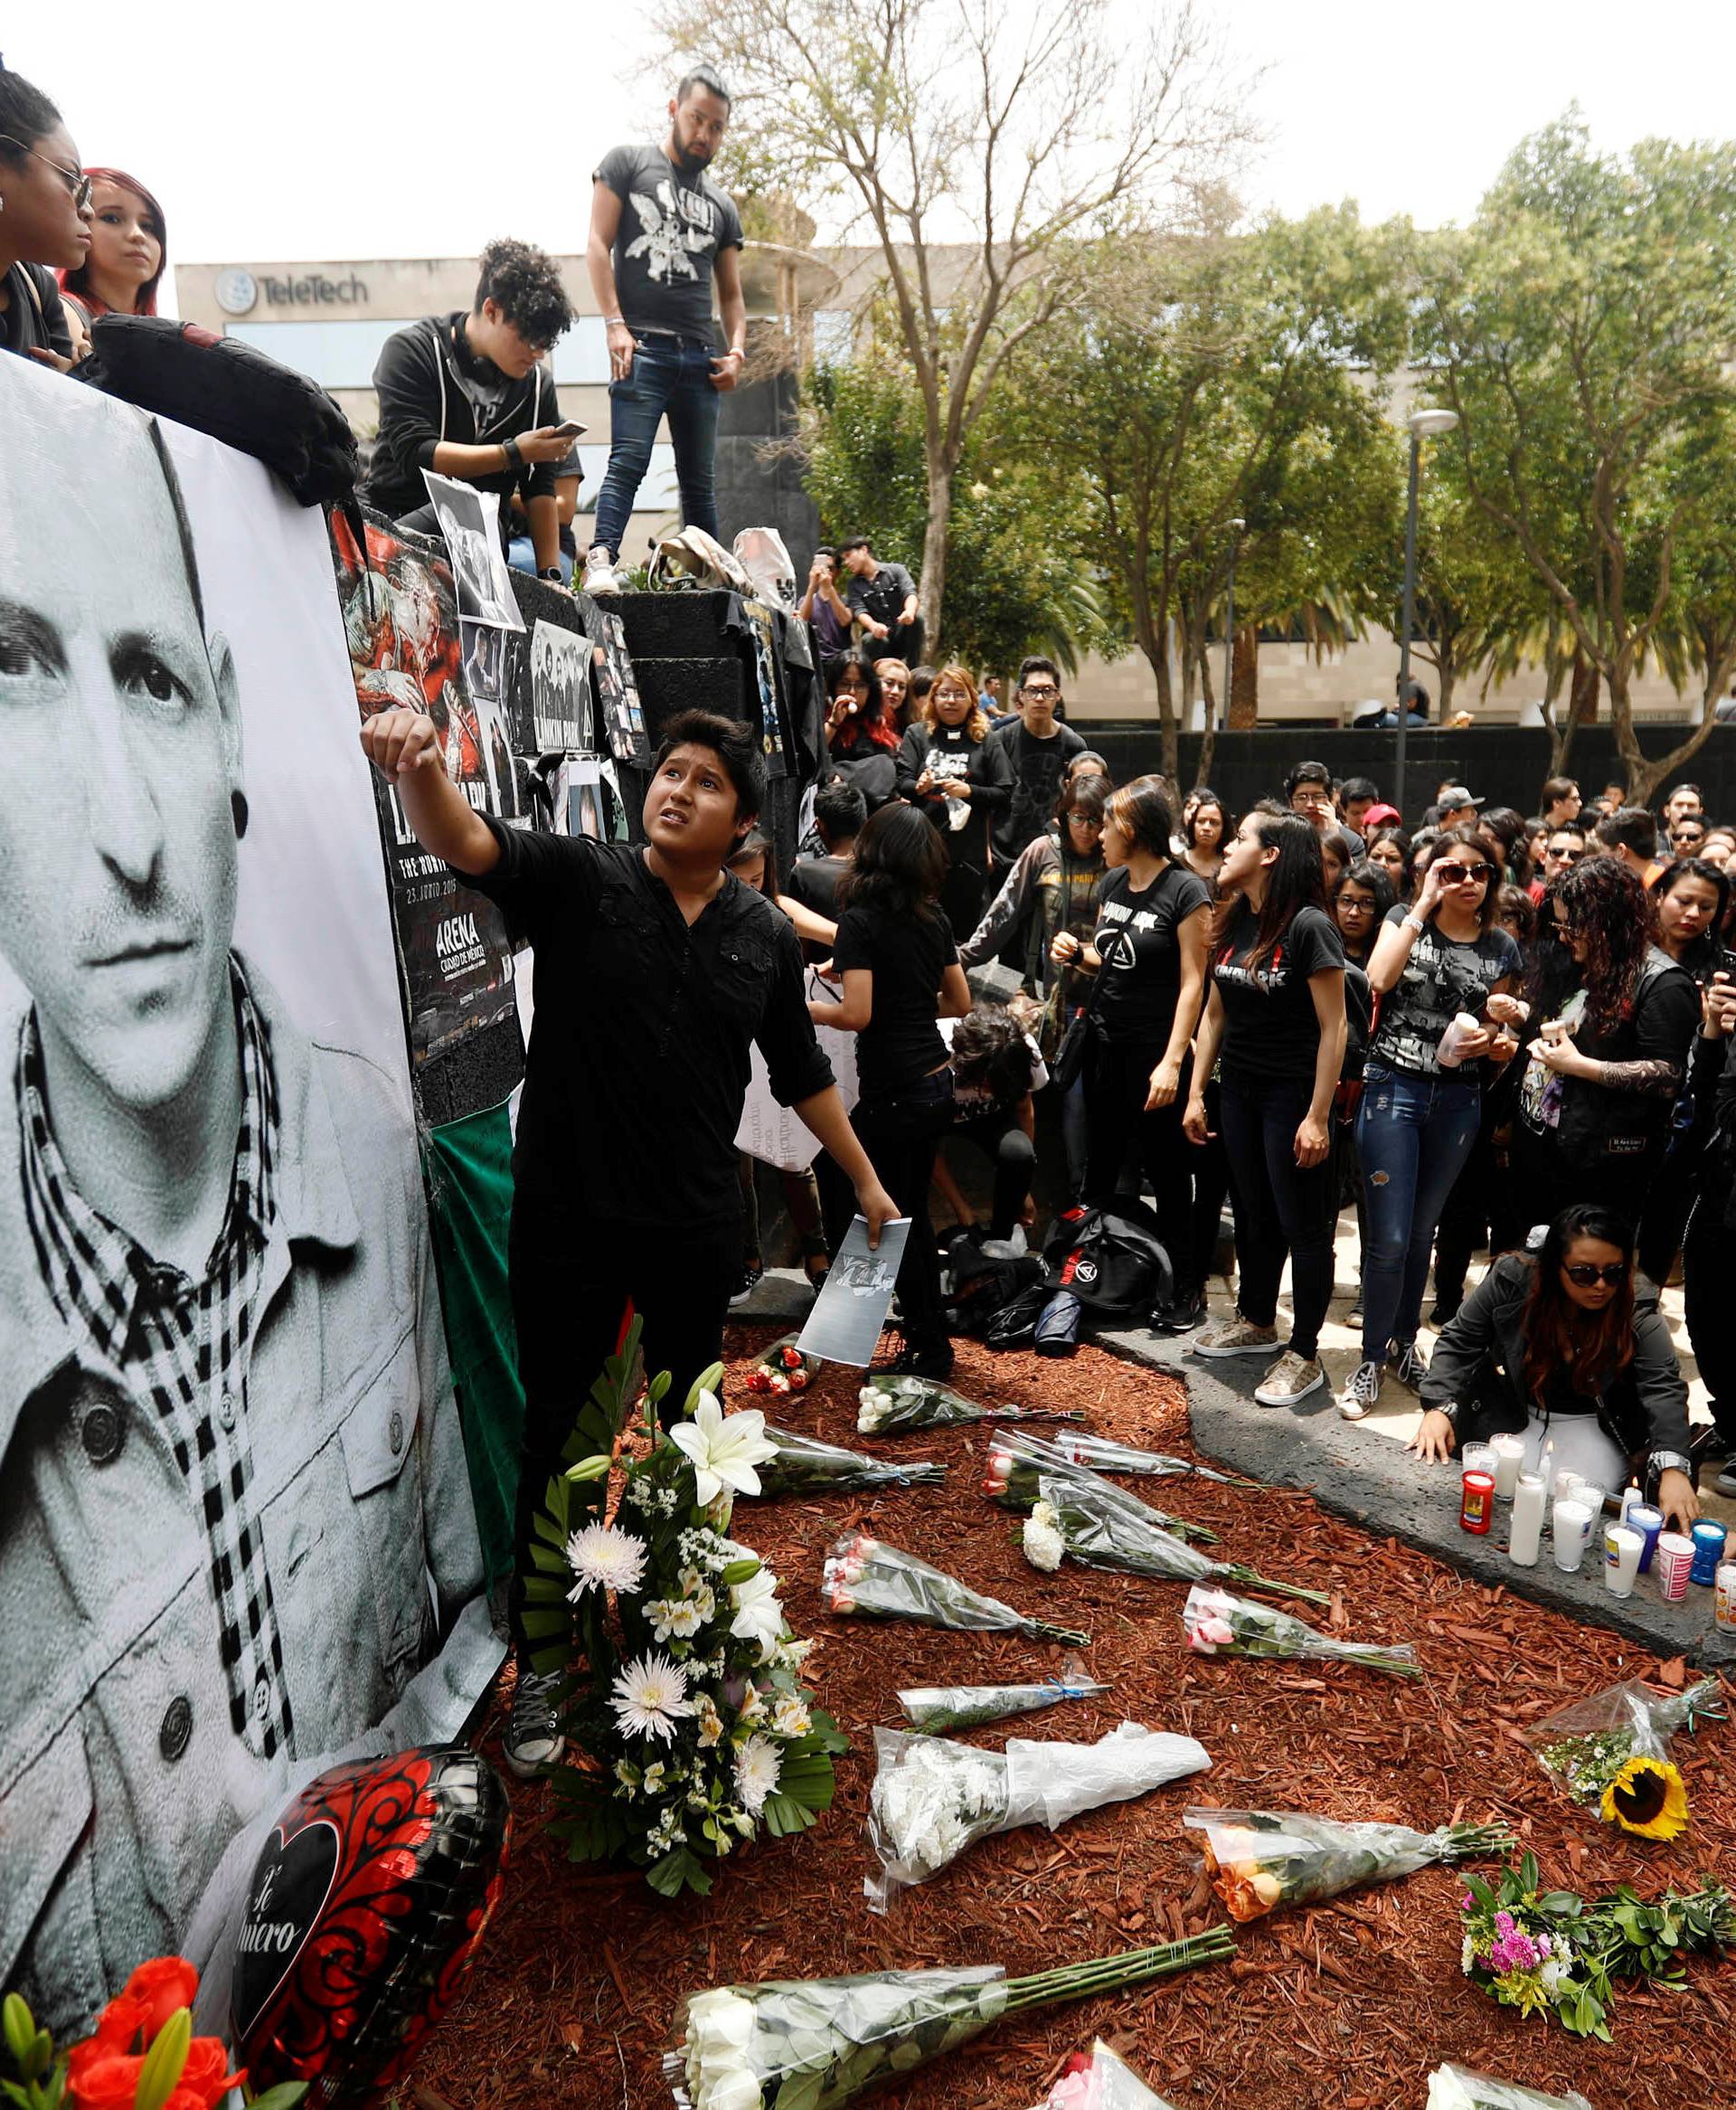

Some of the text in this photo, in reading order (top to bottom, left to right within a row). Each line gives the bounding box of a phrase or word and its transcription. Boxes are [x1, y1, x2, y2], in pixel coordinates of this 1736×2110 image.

[259, 272, 368, 304] TeleTech
[533, 716, 563, 752] LINKIN
[399, 854, 449, 880] THE HUNTI
[436, 912, 480, 958] ARENA
[440, 954, 461, 974] CIUDAD
[459, 951, 469, 966] DE
